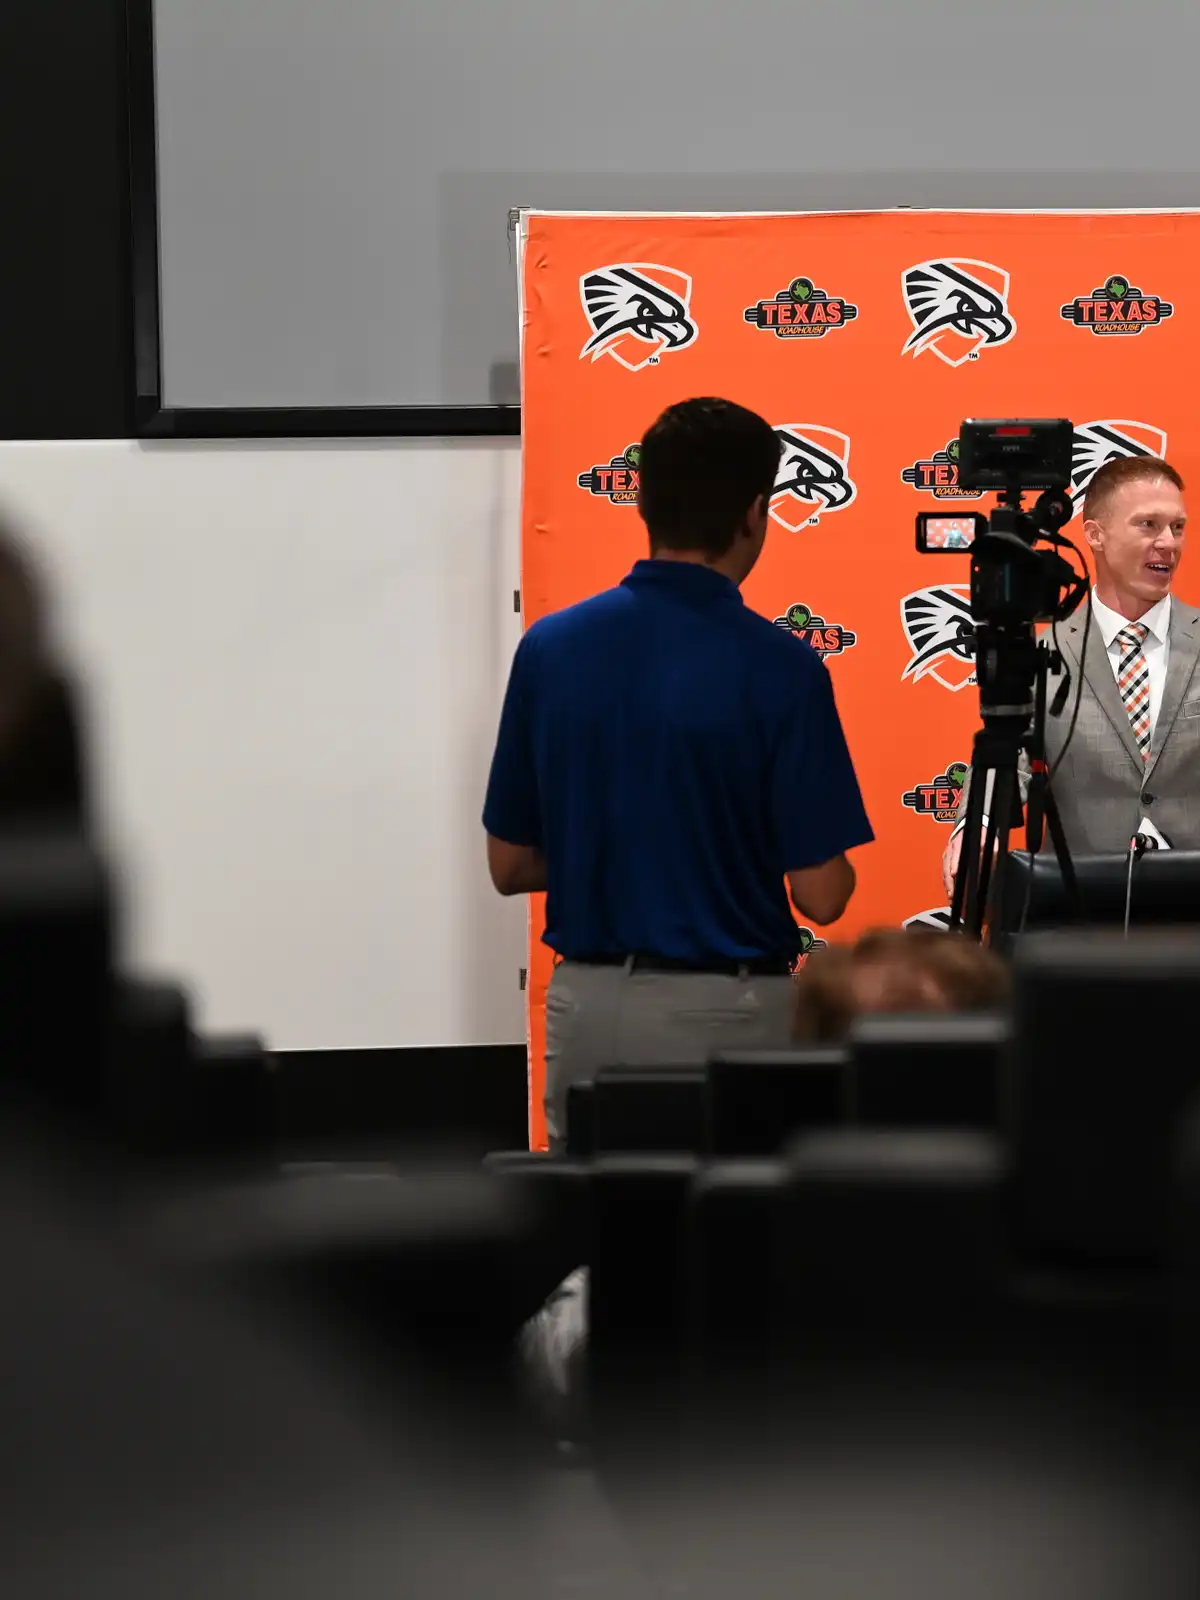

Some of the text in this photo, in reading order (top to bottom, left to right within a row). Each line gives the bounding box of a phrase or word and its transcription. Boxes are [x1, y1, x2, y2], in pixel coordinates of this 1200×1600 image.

[762, 302, 842, 325] TEXAS
[1078, 300, 1157, 322] TEXAS
[777, 326, 825, 335] ROADHOUSE
[1094, 323, 1141, 332] ROADHOUSE
[596, 470, 641, 491] TEX
[920, 788, 964, 809] TEX
